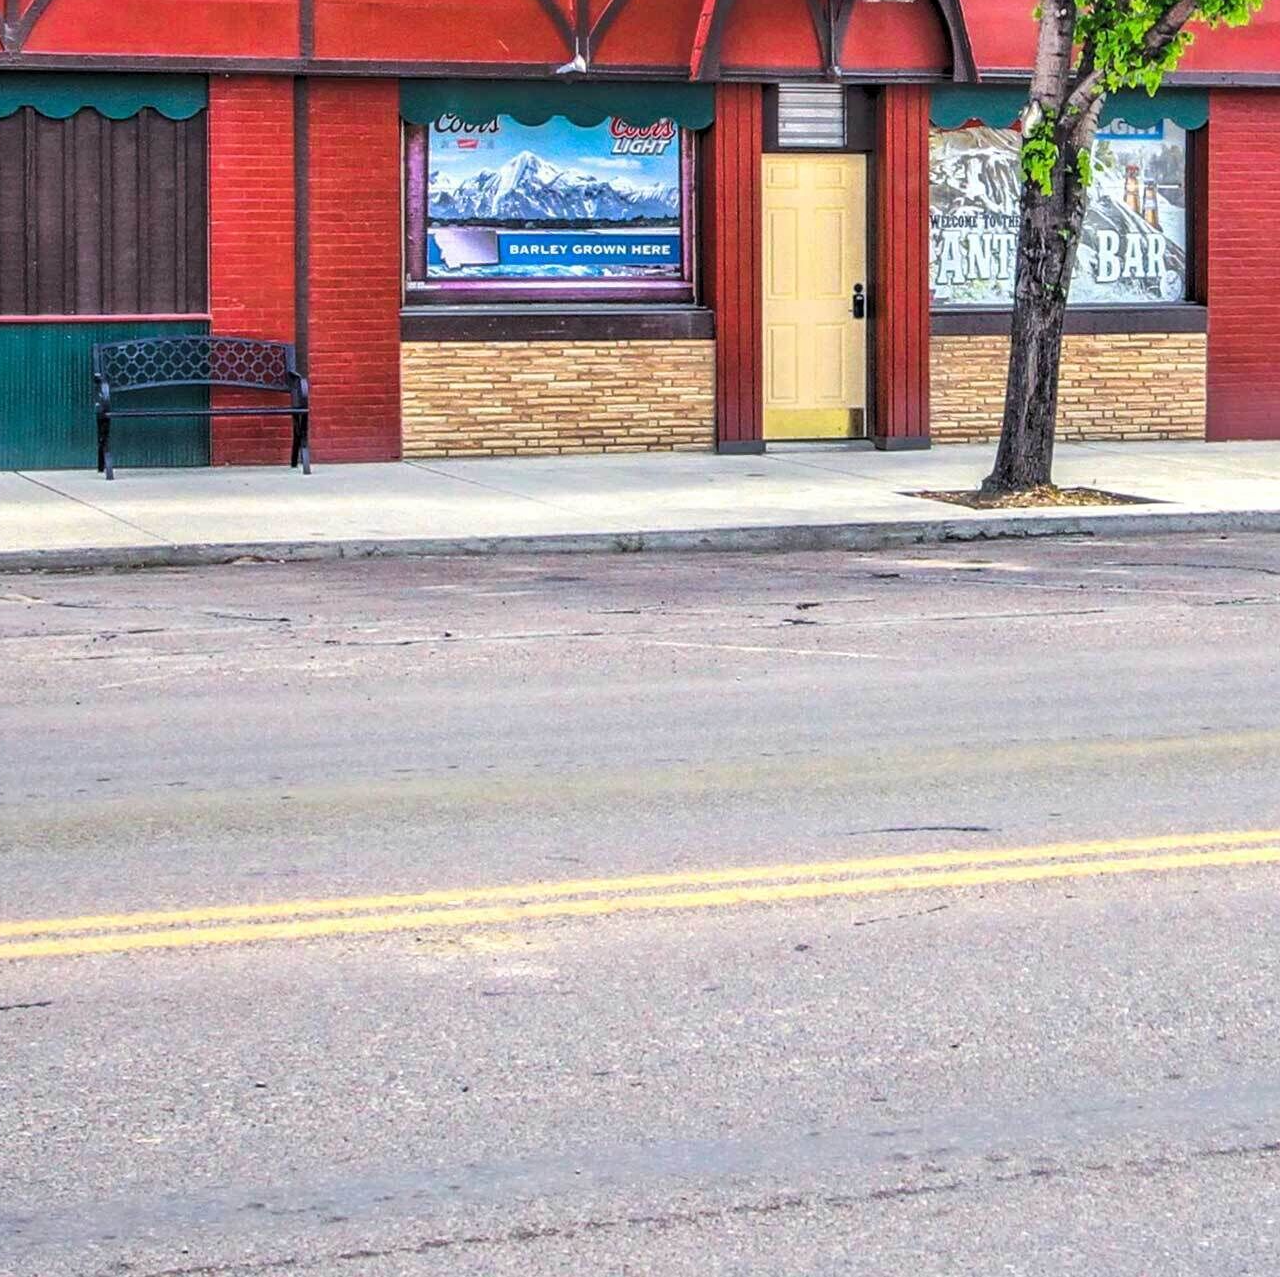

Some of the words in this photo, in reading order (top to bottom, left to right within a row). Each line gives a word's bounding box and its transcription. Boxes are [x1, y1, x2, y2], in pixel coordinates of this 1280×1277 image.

[611, 139, 671, 155] LIGHT
[930, 214, 977, 229] WELCOME
[983, 213, 996, 229] TO
[509, 244, 568, 255] BARLEY
[572, 244, 626, 255] GROWN
[631, 244, 671, 255] HERE
[1095, 229, 1167, 283] BAR
